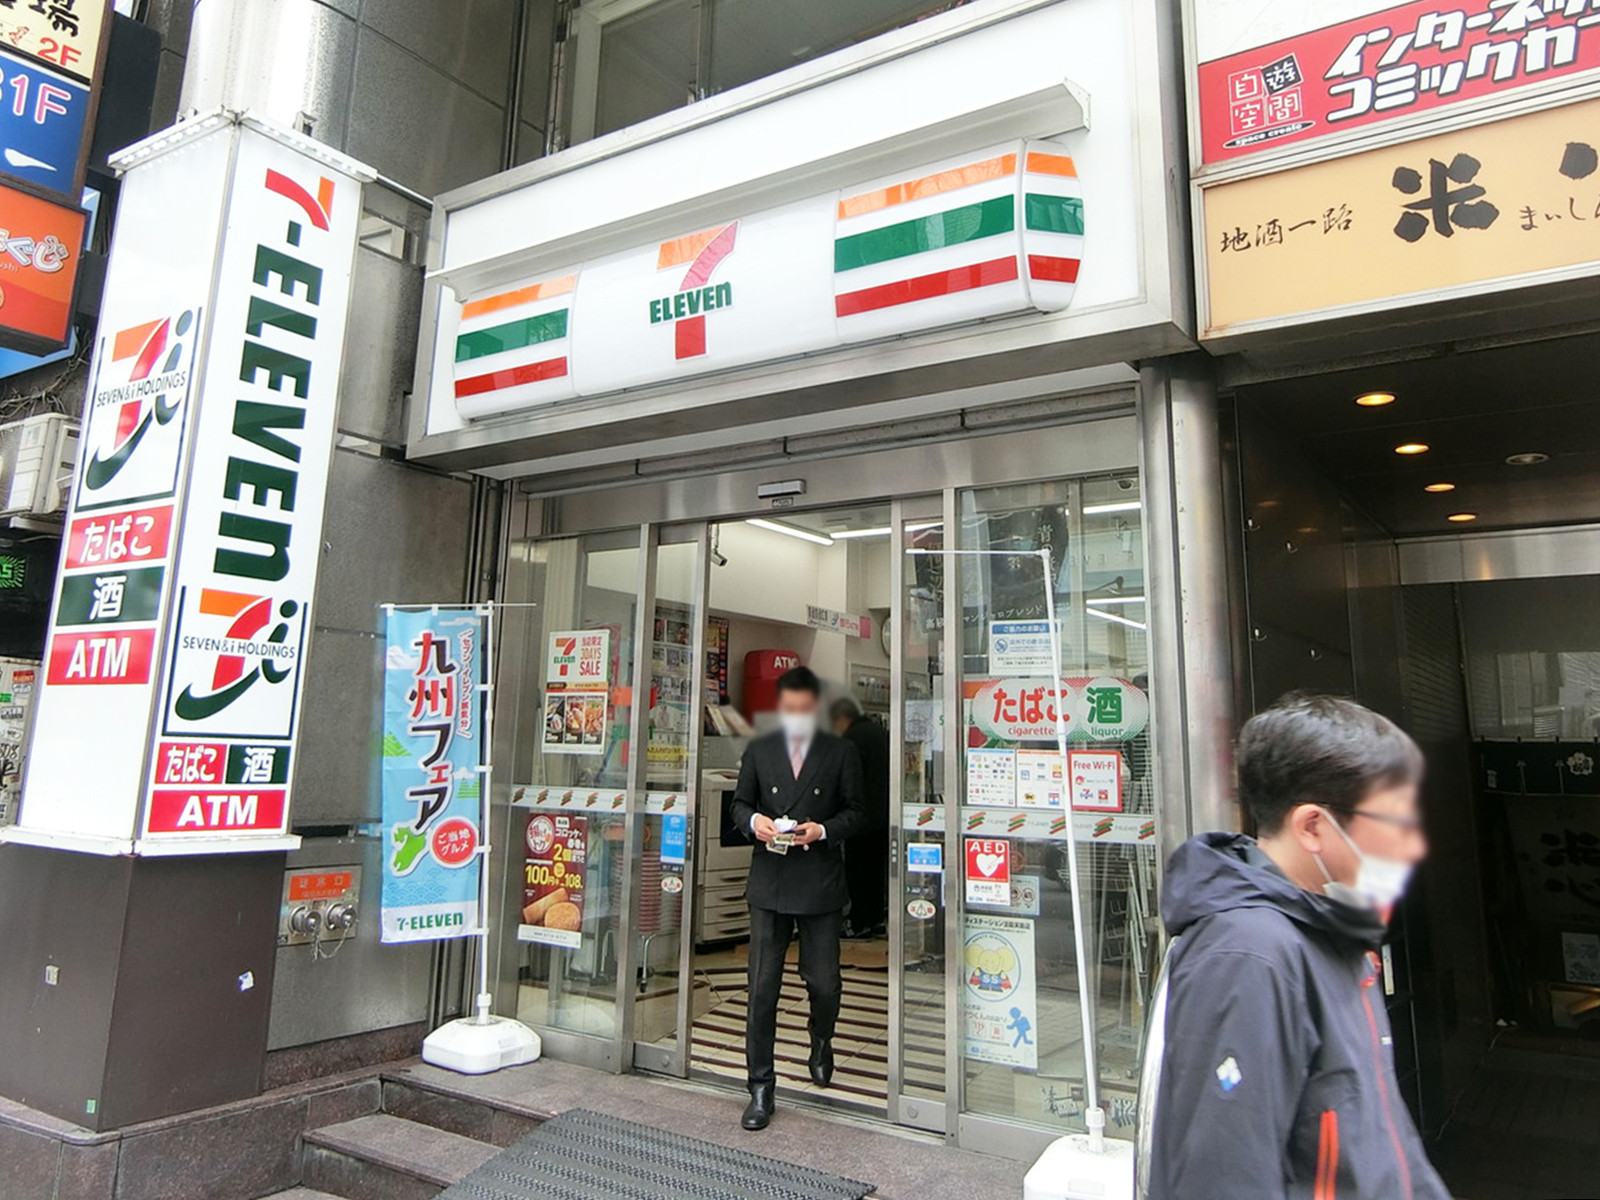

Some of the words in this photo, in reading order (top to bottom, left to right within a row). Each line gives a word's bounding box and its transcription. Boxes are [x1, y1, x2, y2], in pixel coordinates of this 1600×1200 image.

[37, 37, 82, 67] 2F
[1324, 0, 1600, 79] インターネッ
[0, 66, 72, 125] 1F
[1234, 60, 1297, 99] 自遊
[1234, 93, 1300, 129] 空間
[1234, 132, 1266, 146] space
[1391, 153, 1501, 243] 米
[1518, 196, 1600, 231] まいし
[1220, 202, 1354, 254] 地酒一路
[648, 280, 733, 325] ELEVEN
[137, 370, 187, 398] HOLDINGS
[212, 167, 336, 582] 7-ELEVEN
[79, 514, 156, 564] たばこ
[89, 575, 127, 621] 酒
[66, 636, 131, 679] ATM
[237, 641, 296, 659] HOLDINGS
[579, 660, 601, 676] SALE
[993, 686, 1071, 724] たばこ
[1086, 686, 1123, 724] 酒
[408, 632, 457, 831] 九州フェア
[1007, 724, 1056, 737] cigarette
[1091, 726, 1125, 738] liquor
[164, 744, 217, 783] たばこ
[241, 746, 276, 783] 酒
[1073, 760, 1092, 770] Free
[1093, 760, 1116, 770] Wi-Fi
[176, 794, 259, 827] ATM
[969, 841, 1006, 854] AED
[396, 911, 463, 932] 7-ELEVEN
[982, 975, 1000, 985] SS
